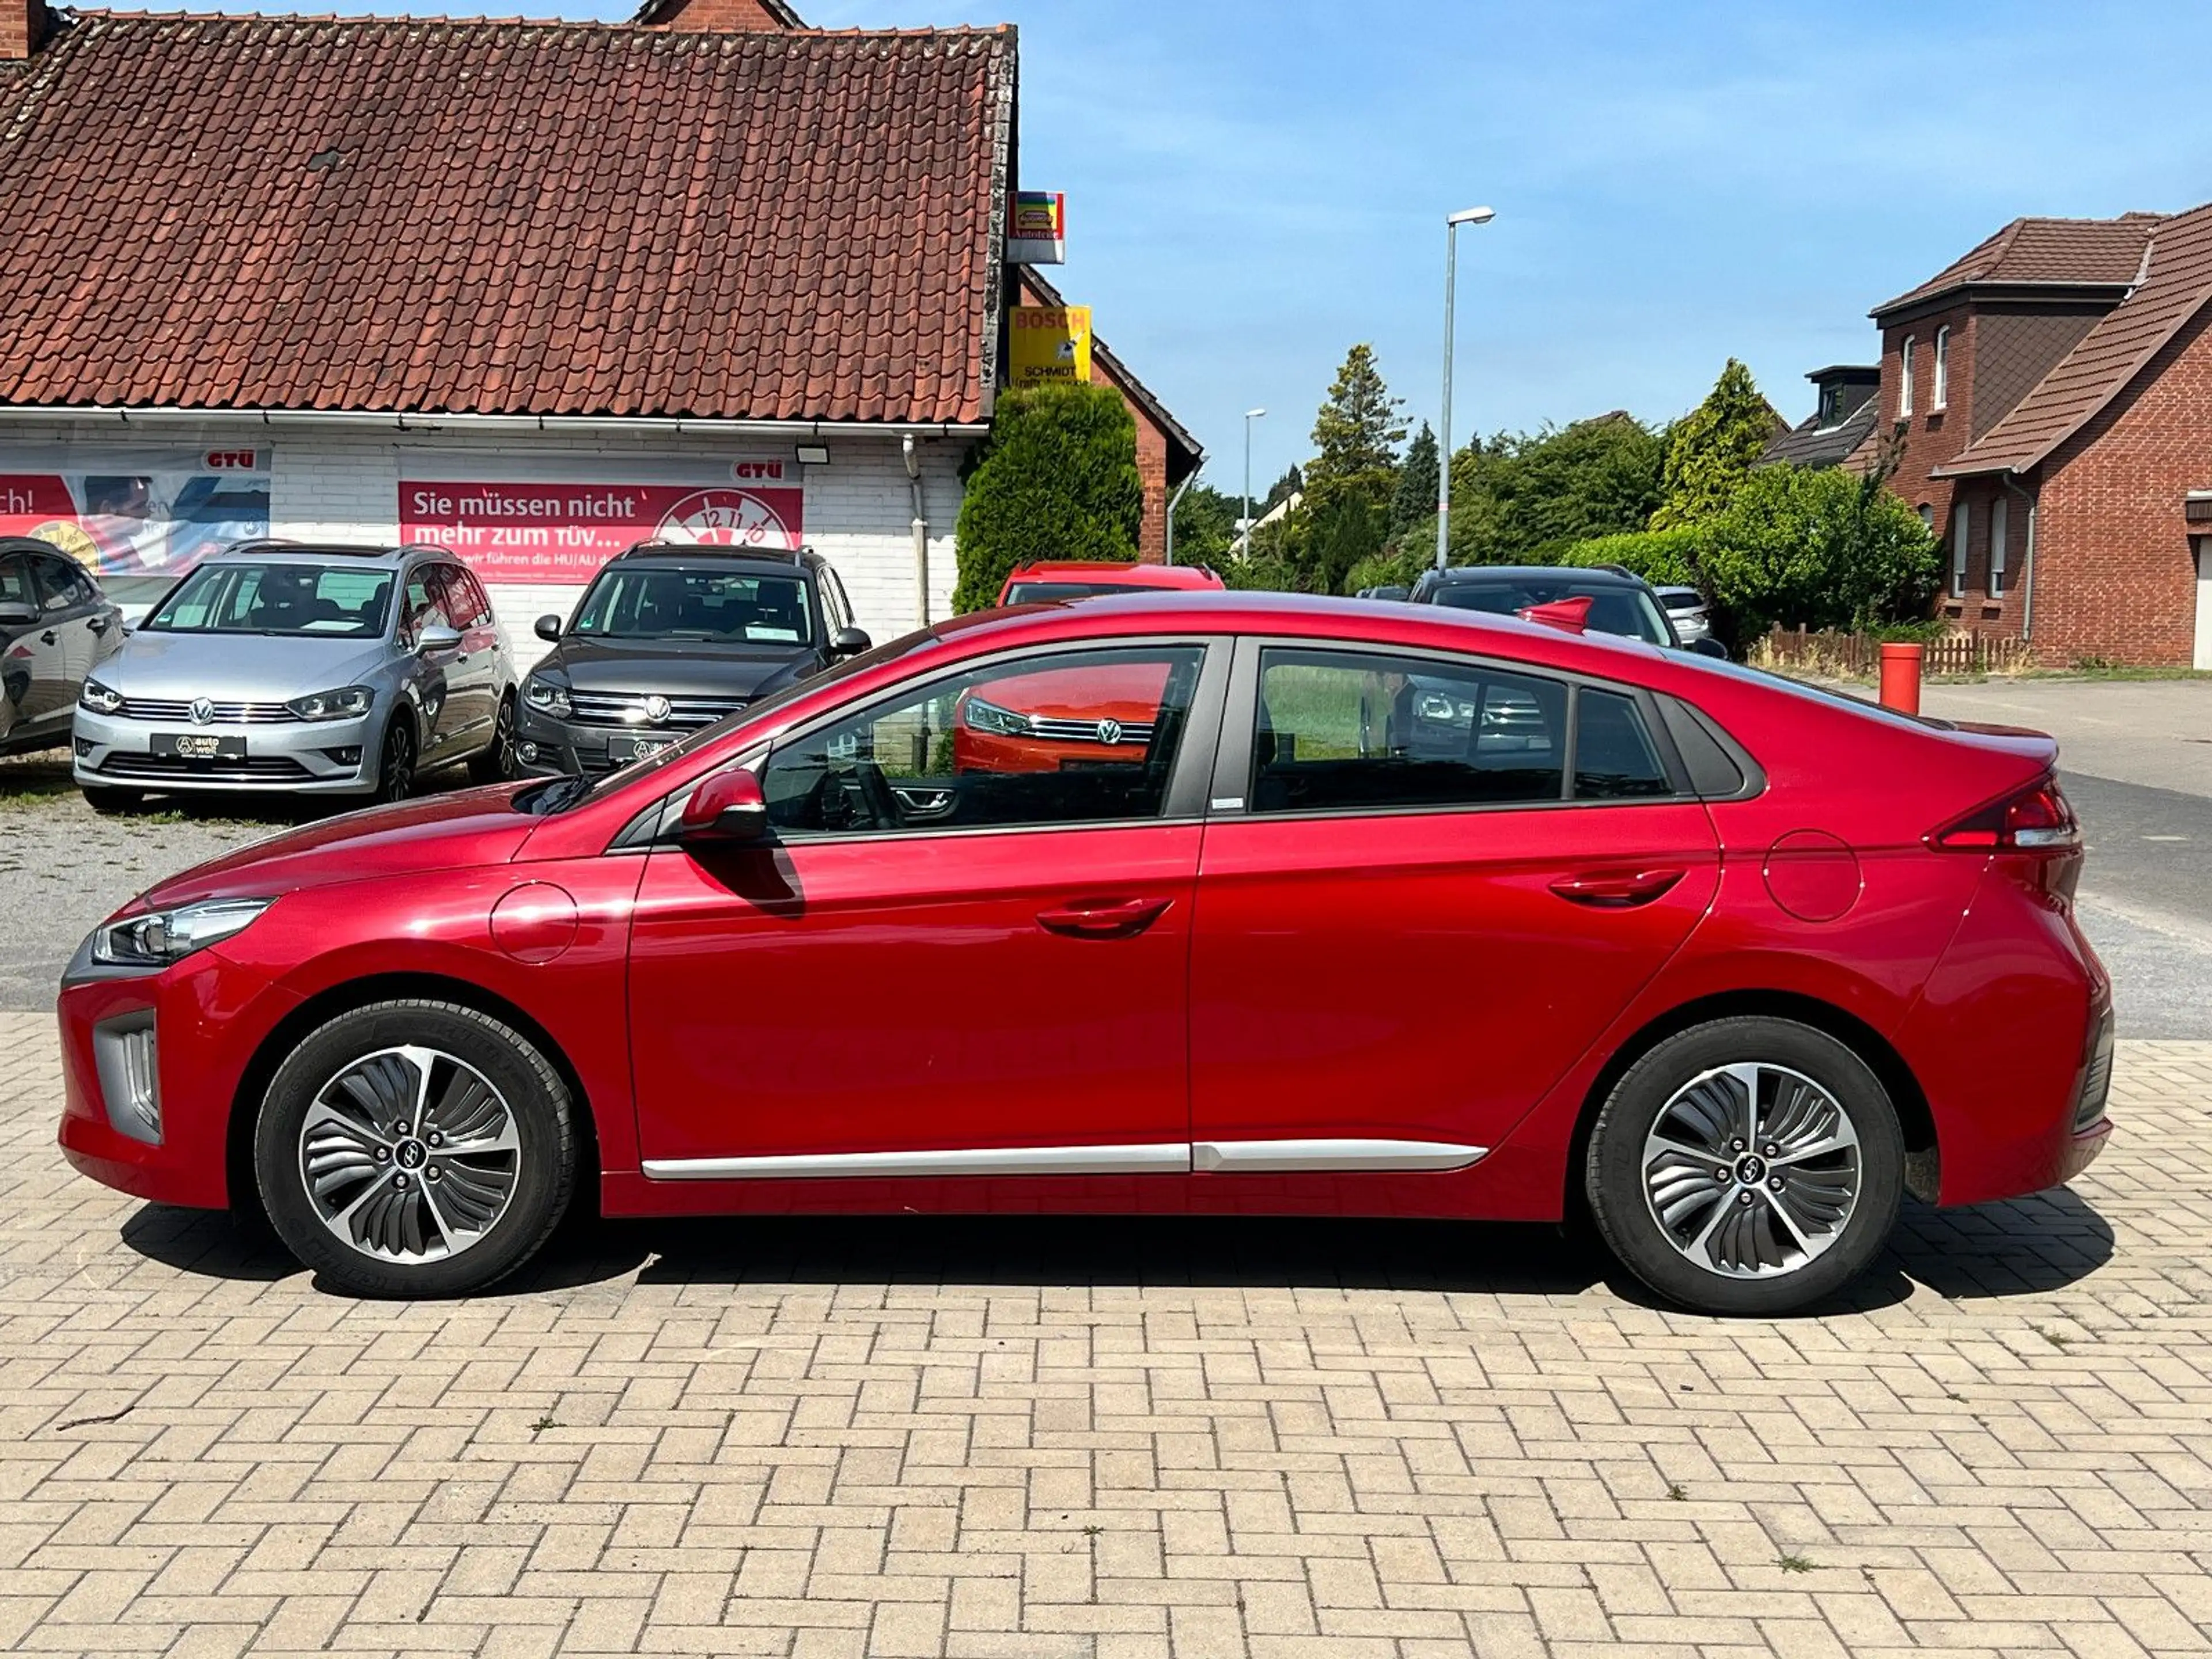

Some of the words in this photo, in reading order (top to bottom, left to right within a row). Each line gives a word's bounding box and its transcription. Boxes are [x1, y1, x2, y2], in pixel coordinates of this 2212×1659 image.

[1016, 312, 1085, 330] BOSCH
[1025, 366, 1076, 377] SCHMIDT
[208, 449, 254, 468] GTÜ
[736, 460, 783, 479] GTÜ
[414, 492, 452, 514] Sie
[460, 493, 560, 517] müssen
[568, 494, 635, 517] nicht
[415, 521, 485, 545] mehr
[491, 527, 548, 546] zum
[487, 552, 529, 565] führen
[532, 553, 551, 565] die
[554, 553, 596, 569] HU/AU
